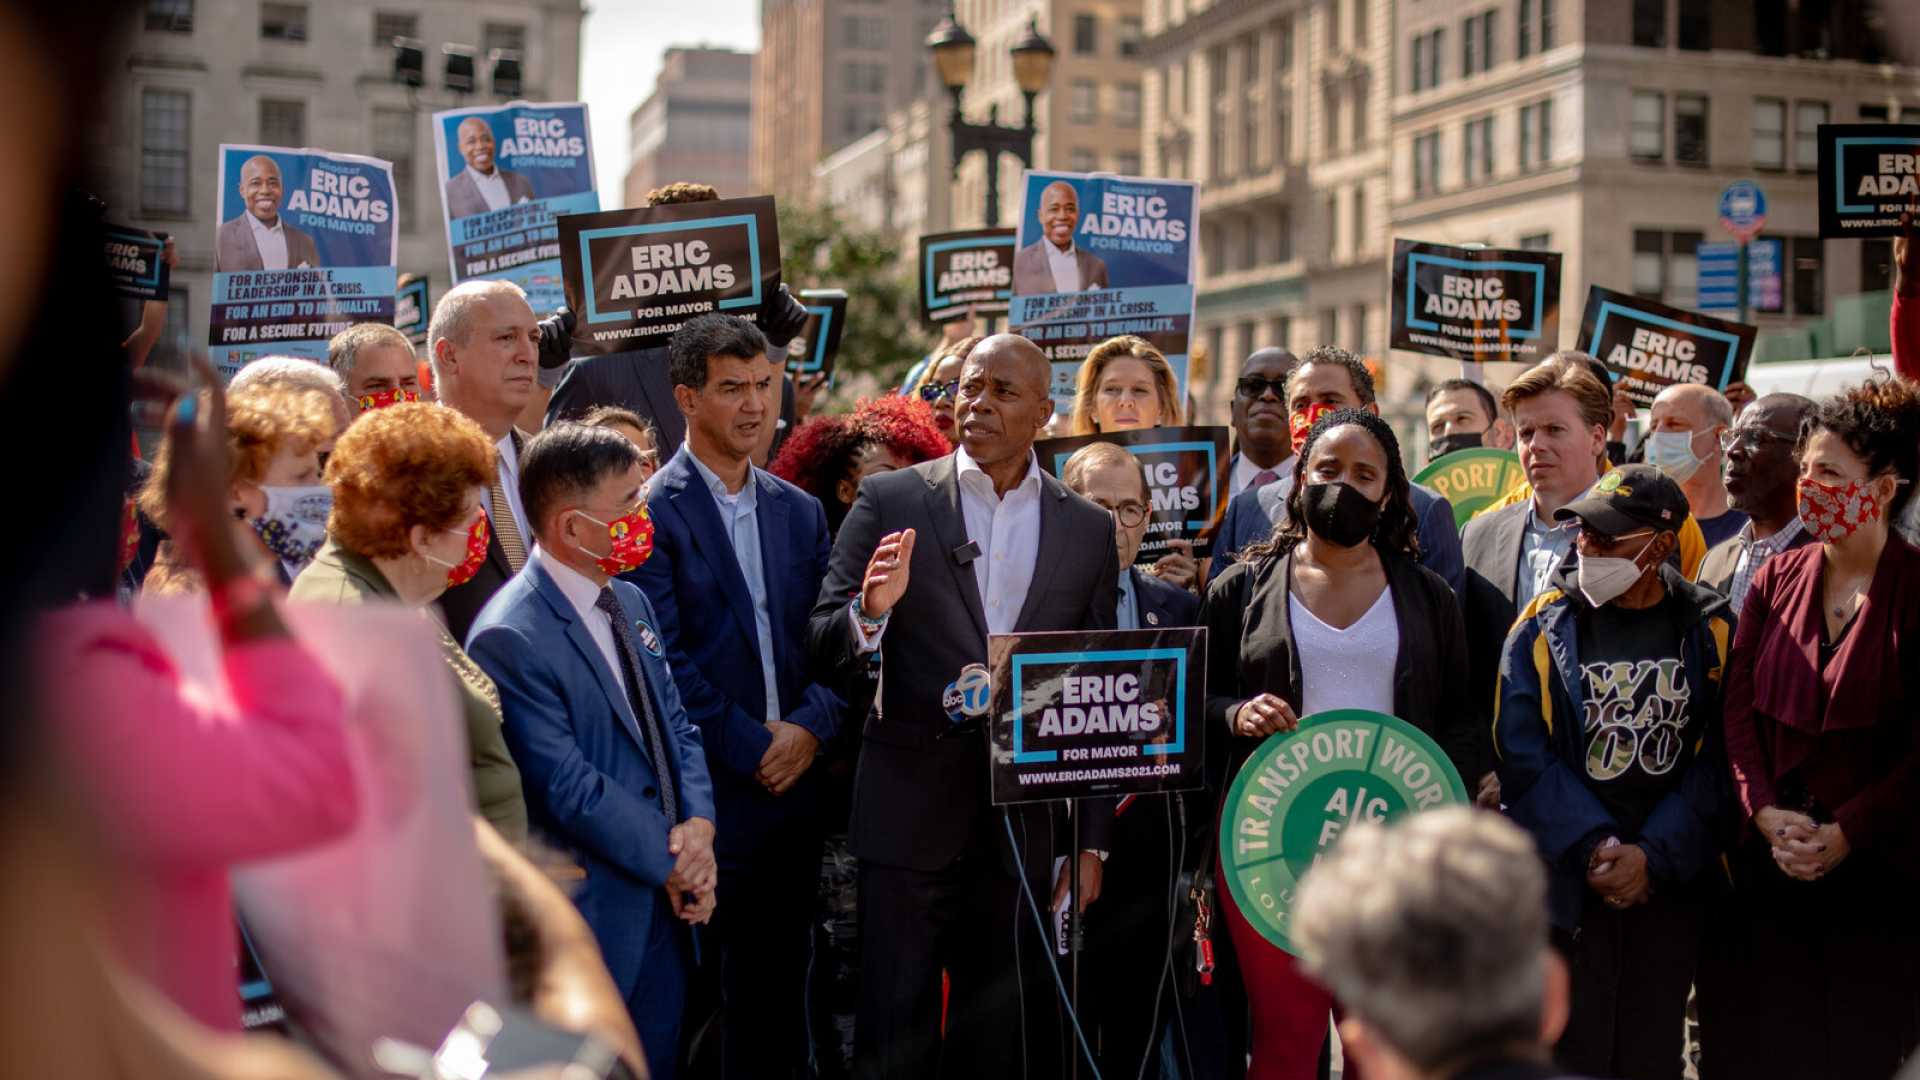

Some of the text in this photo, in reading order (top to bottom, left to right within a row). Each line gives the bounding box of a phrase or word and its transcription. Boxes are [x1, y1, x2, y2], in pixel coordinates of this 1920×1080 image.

[514, 117, 566, 138] ERIC
[499, 137, 585, 159] ADAMS
[1878, 153, 1920, 174] ERI
[311, 168, 370, 199] ERIC
[1857, 175, 1920, 196] ADA
[287, 189, 389, 223] ADAMS
[1103, 192, 1168, 218] ERIC
[299, 214, 377, 236] FOR MAYOR
[1080, 213, 1186, 242] ADAMS
[631, 240, 711, 270] ERIC
[1089, 236, 1174, 255] FOR MAYOR
[466, 260, 488, 276] FOR
[950, 249, 999, 271] ERIC
[228, 274, 252, 287] FOR
[610, 264, 735, 300] ADAMS
[938, 266, 1011, 292] ADAMS
[1443, 274, 1504, 299] ERIC
[228, 282, 366, 300] LEADERSHIP IN A CRISIS.
[225, 305, 248, 320] FOR
[251, 304, 269, 318] AN
[270, 303, 295, 317] END
[298, 302, 314, 315] TO
[637, 301, 713, 319] FOR MAYOR
[1025, 297, 1045, 309] FOR
[1094, 305, 1106, 317] IN
[1110, 304, 1117, 316] A
[1120, 302, 1158, 314] CRISIS.
[1424, 293, 1521, 321] ADAMS
[222, 327, 246, 342] FOR
[249, 326, 258, 340] A
[260, 323, 306, 339] SECURE
[1441, 323, 1501, 338] FOR MAYOR
[1632, 327, 1696, 361] ERIC
[1607, 344, 1709, 385] ADAMS
[1144, 462, 1178, 487] IC
[1146, 521, 1183, 533] AYOR
[1063, 673, 1140, 704] ERIC
[1580, 659, 1691, 703] WU
[943, 694, 963, 708] abc
[1038, 702, 1161, 737] ADAMS
[1063, 745, 1137, 761] FOR MAYOR
[1586, 720, 1683, 781] 00
[1018, 763, 1181, 785] WWW.ERICADAMS2021.COM
[1239, 728, 1444, 854] TRANSPORT WOR
